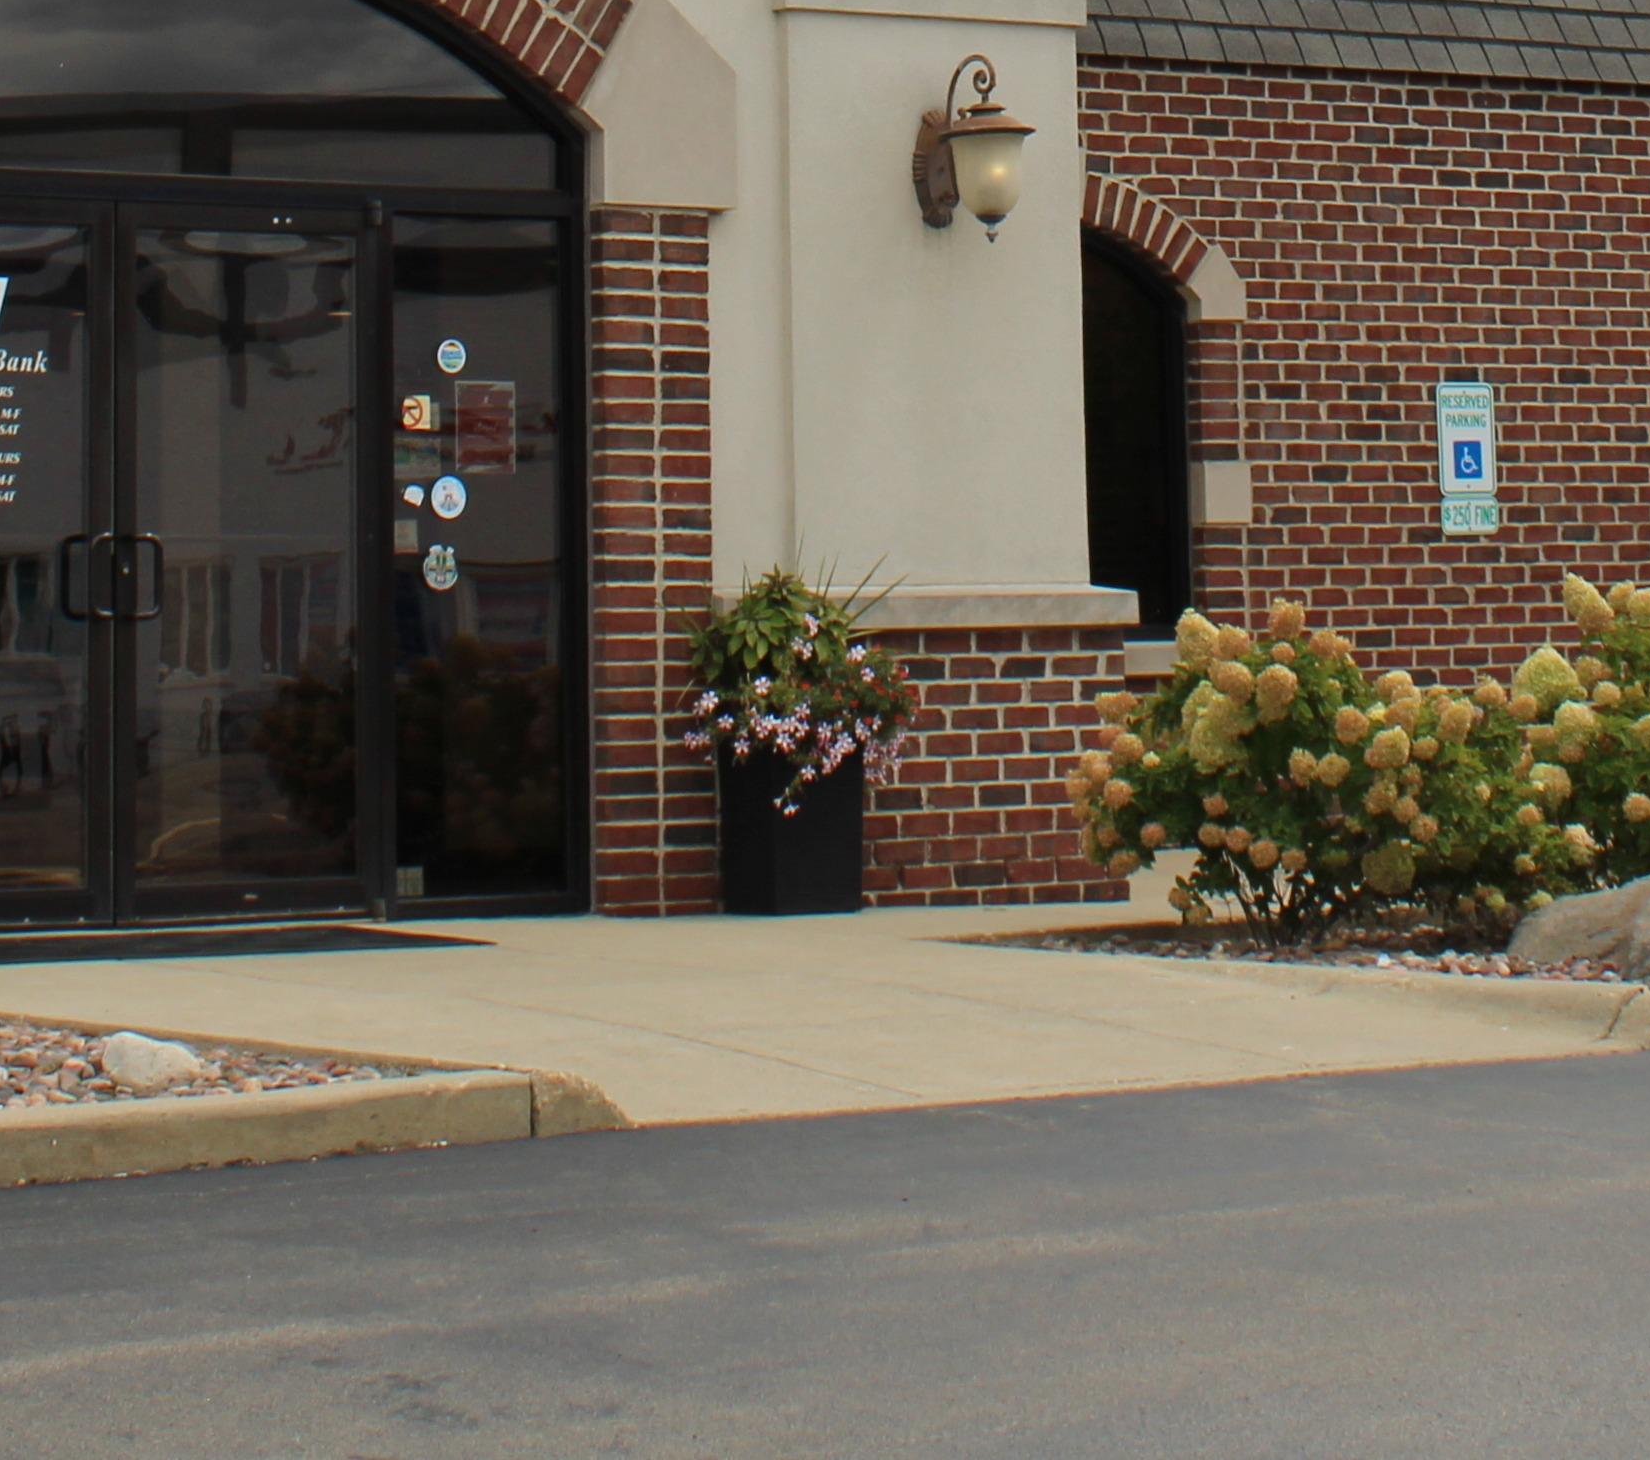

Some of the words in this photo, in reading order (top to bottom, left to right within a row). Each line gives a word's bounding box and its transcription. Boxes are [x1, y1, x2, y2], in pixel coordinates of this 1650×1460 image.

[1441, 394, 1489, 410] RESERVED
[1445, 413, 1487, 428] PARKING
[1474, 505, 1496, 526] FINE
